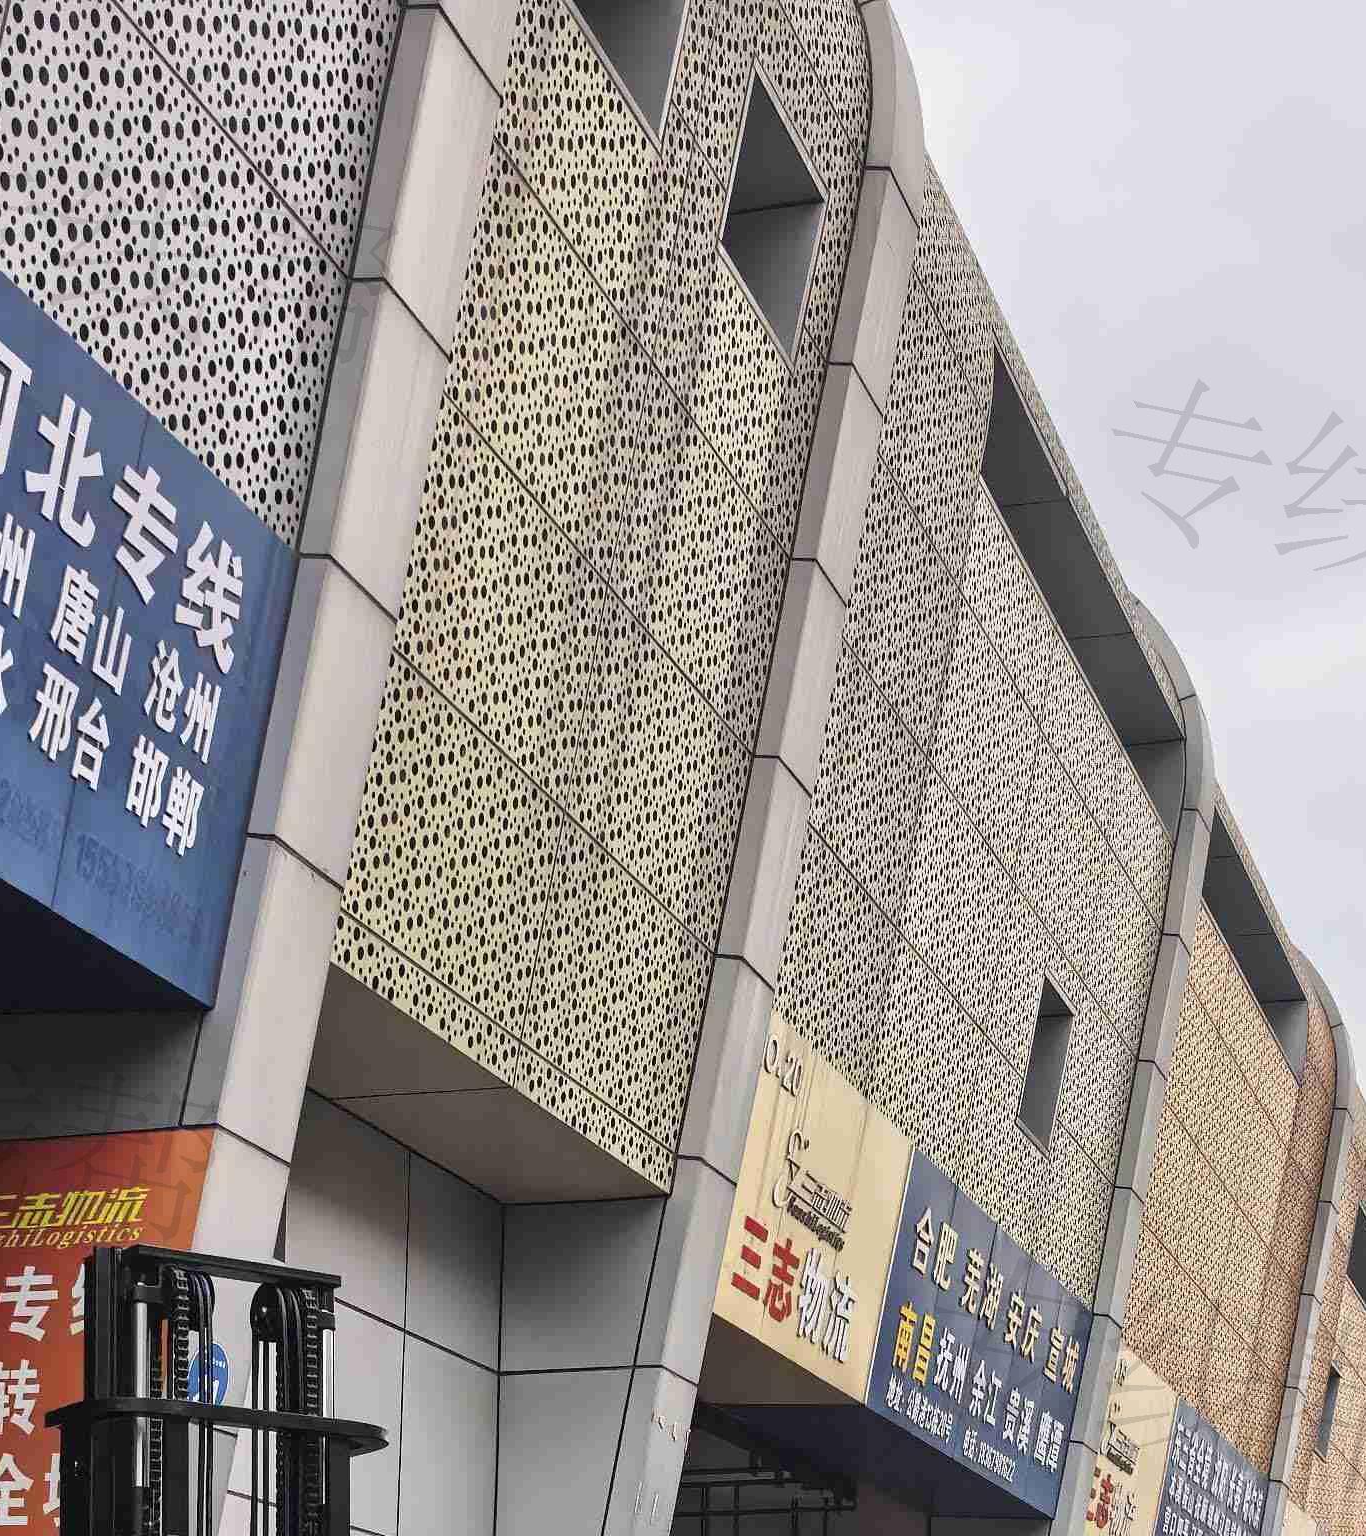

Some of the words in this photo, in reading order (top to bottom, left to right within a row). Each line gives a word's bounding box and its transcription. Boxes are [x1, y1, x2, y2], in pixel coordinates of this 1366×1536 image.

[29, 662, 111, 793] 邢台
[125, 734, 206, 856] 邯郸
[49, 567, 134, 697] 唐山
[143, 639, 222, 766] 沧州
[730, 1214, 857, 1365] 三志物流
[910, 1206, 959, 1292] 合肥
[961, 1247, 1004, 1330] 芜湖
[1004, 1288, 1044, 1364] 安庆
[1042, 1326, 1080, 1394] 宣城
